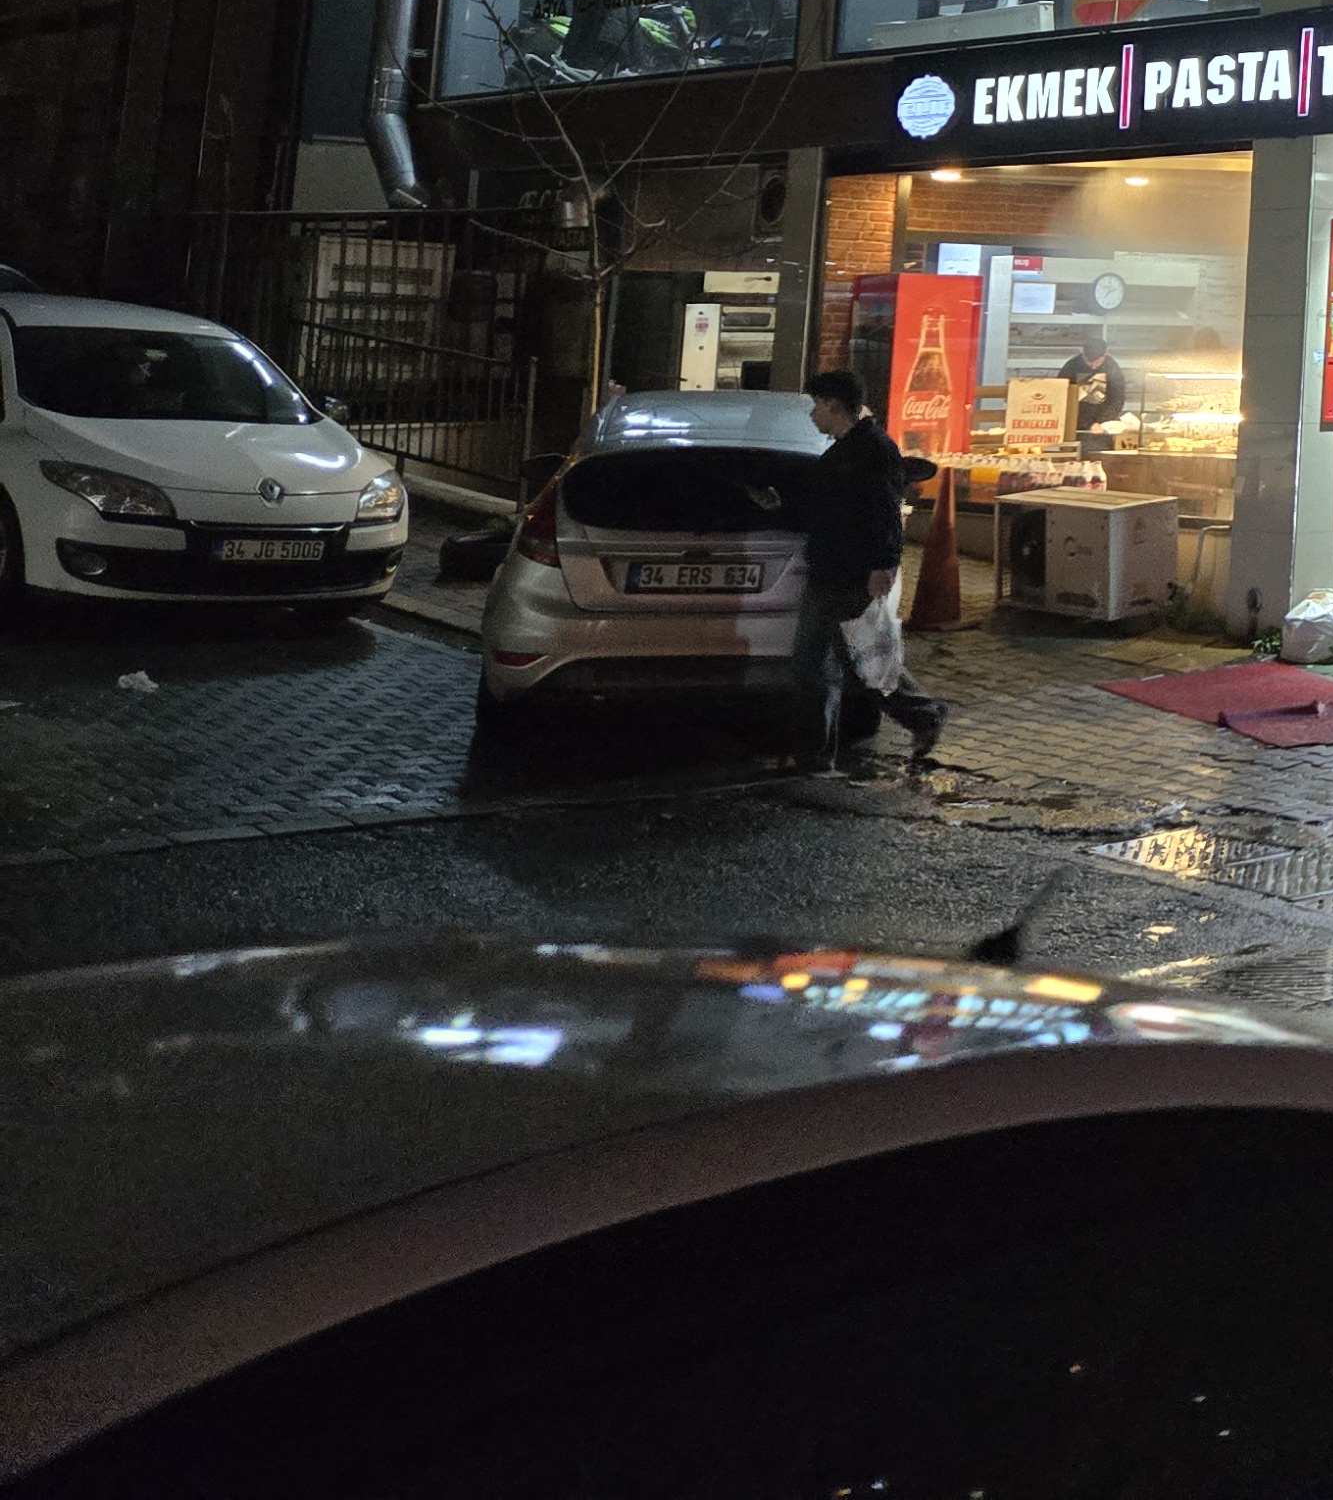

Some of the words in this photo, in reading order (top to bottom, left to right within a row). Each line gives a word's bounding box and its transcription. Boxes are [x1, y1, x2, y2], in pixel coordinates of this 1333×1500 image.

[972, 66, 1116, 125] EKMEK
[1143, 49, 1293, 112] PASTA
[225, 541, 245, 558] 34
[254, 541, 275, 558] JG
[280, 541, 321, 558] 5006
[641, 567, 664, 585] 34
[676, 566, 713, 585] ERS
[724, 567, 757, 586] 634
